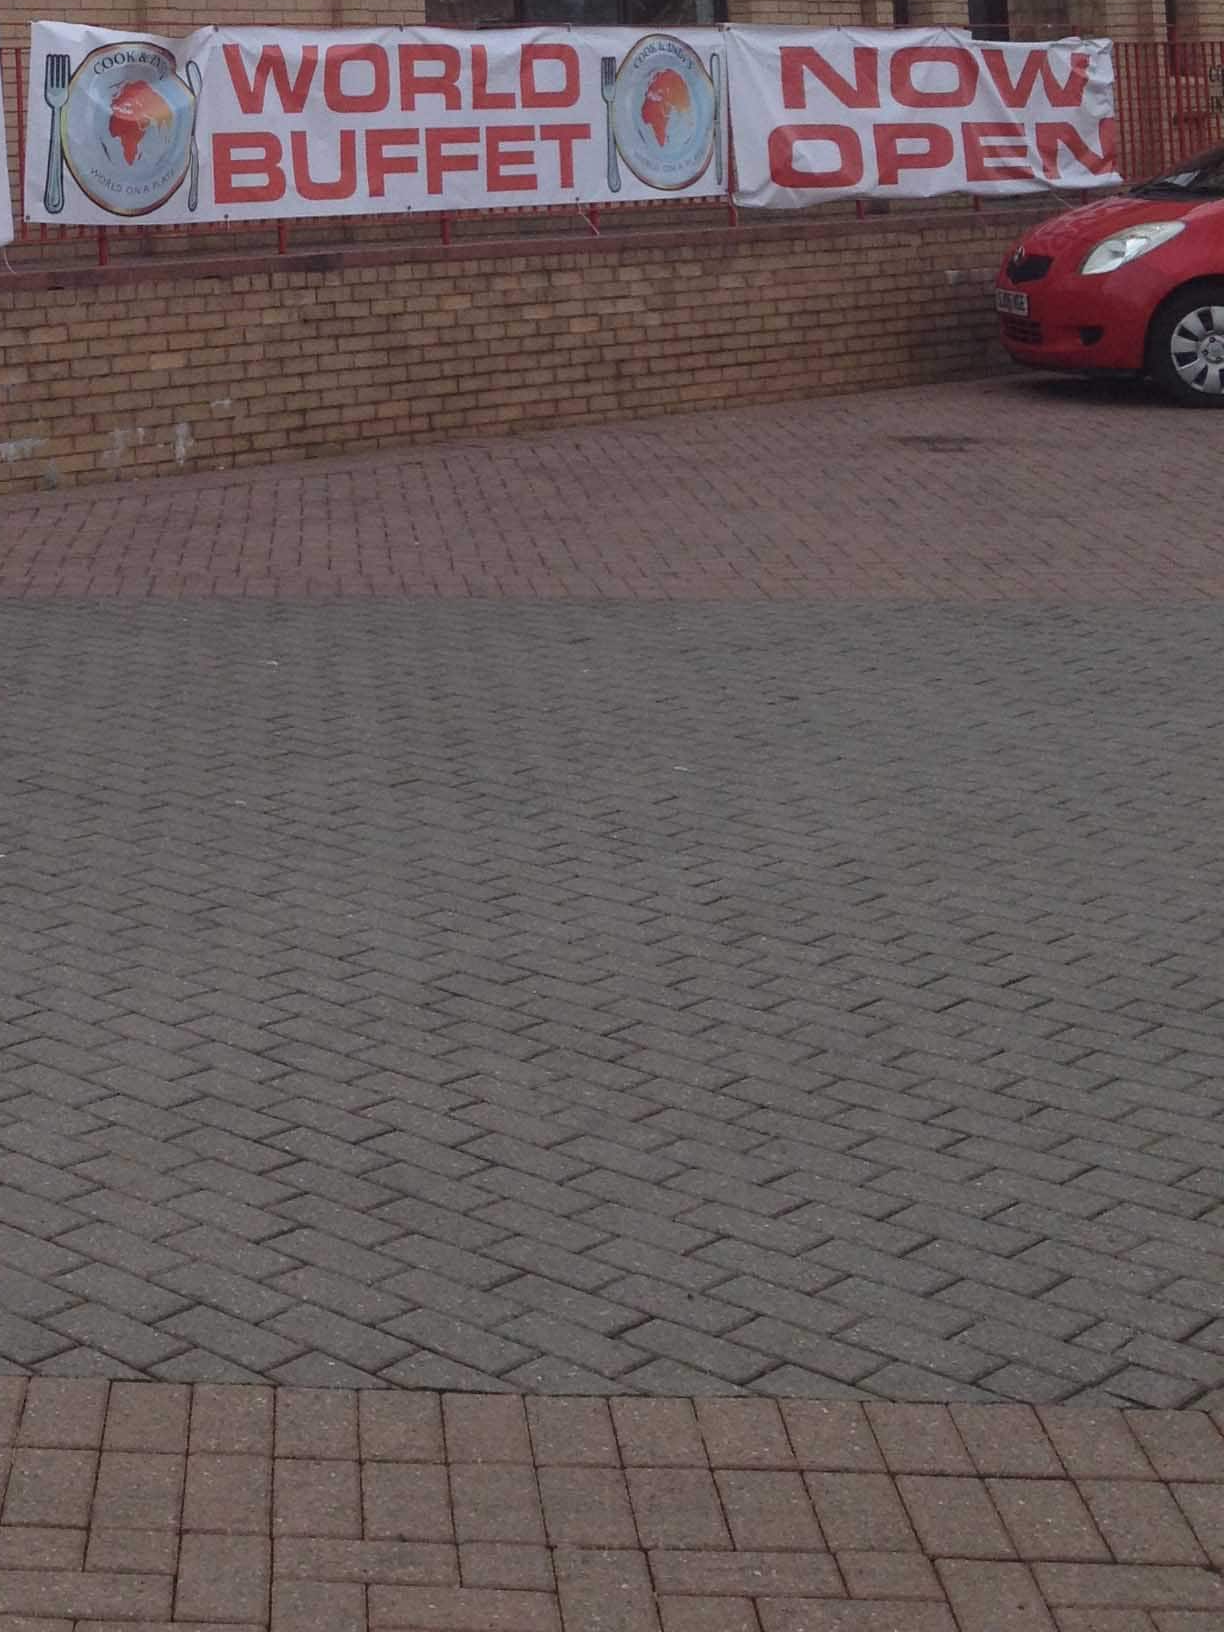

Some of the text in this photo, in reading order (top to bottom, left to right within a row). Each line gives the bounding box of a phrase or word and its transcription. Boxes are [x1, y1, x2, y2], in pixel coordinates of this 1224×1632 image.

[93, 51, 136, 74] COOK
[222, 43, 580, 114] WORLD
[779, 46, 1090, 109] NOW
[212, 124, 591, 204] BUFFET
[767, 117, 1117, 189] OPEN
